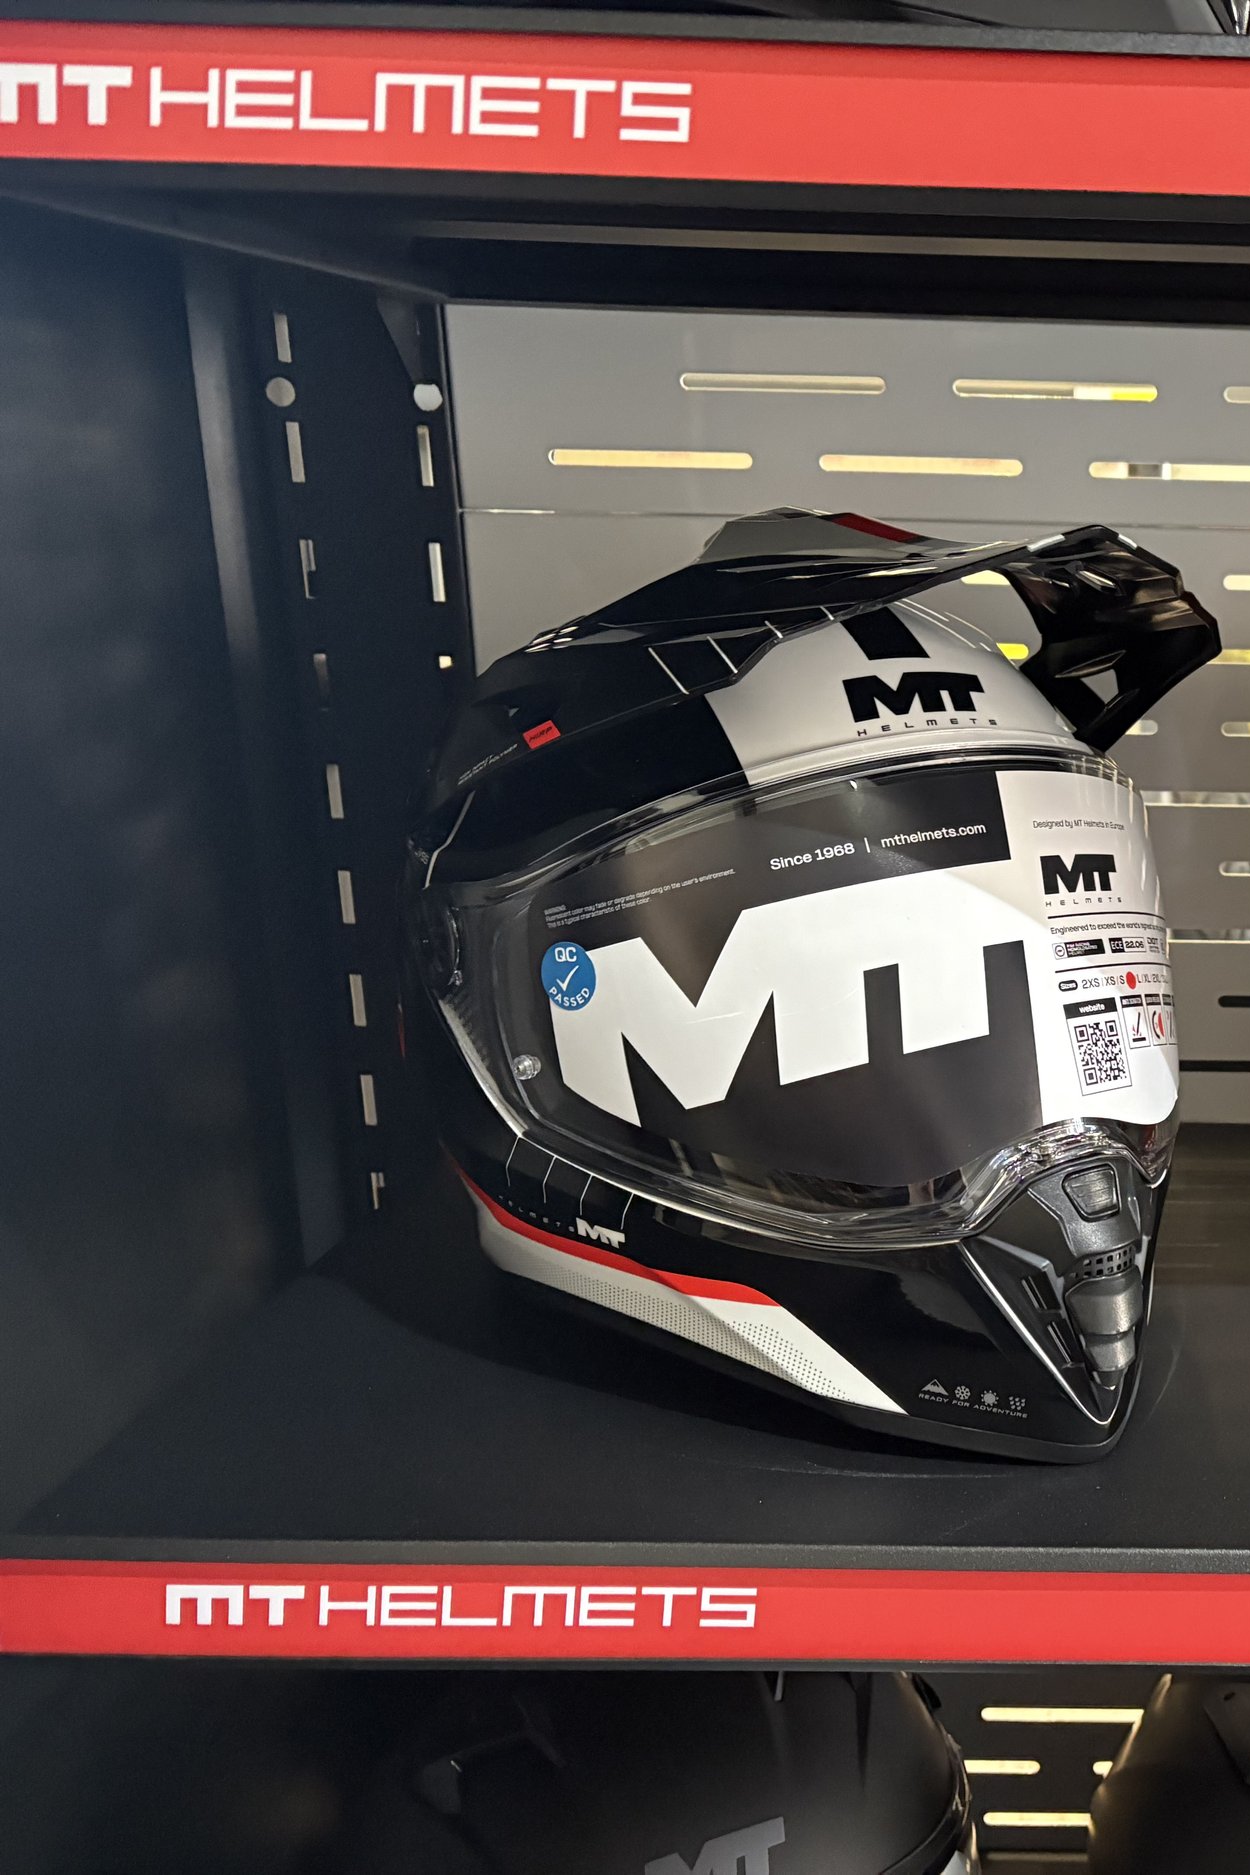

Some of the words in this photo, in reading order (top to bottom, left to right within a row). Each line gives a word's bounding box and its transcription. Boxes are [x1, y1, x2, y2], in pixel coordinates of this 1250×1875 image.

[0, 63, 132, 126] MT
[149, 66, 693, 143] HELMETS
[842, 672, 985, 723] MT
[857, 718, 998, 737] HELMETS
[1033, 820, 1064, 830] Designed
[1065, 820, 1073, 829] by
[769, 851, 813, 871] Since
[815, 842, 856, 862] 1968
[880, 823, 987, 849] mthelmets.com
[1040, 854, 1117, 895] MT
[1045, 897, 1122, 907] HELMETS
[1051, 924, 1089, 935] Engineered
[1098, 922, 1116, 930] exceed
[554, 947, 577, 963] QC
[1111, 940, 1123, 949] ECE
[1125, 940, 1144, 949] 22.06
[549, 858, 1024, 1128] MT
[1082, 978, 1100, 989] 2XS
[1104, 976, 1116, 986] XS
[1120, 975, 1125, 984] S
[548, 985, 590, 1007] PASSED
[1079, 1003, 1105, 1013] website
[576, 1217, 626, 1249] MT
[918, 1393, 949, 1404] READY
[952, 1400, 970, 1408] FOR
[973, 1404, 1028, 1419] ADVENTURE
[165, 1584, 305, 1626] MT
[318, 1585, 757, 1628] HELMETS
